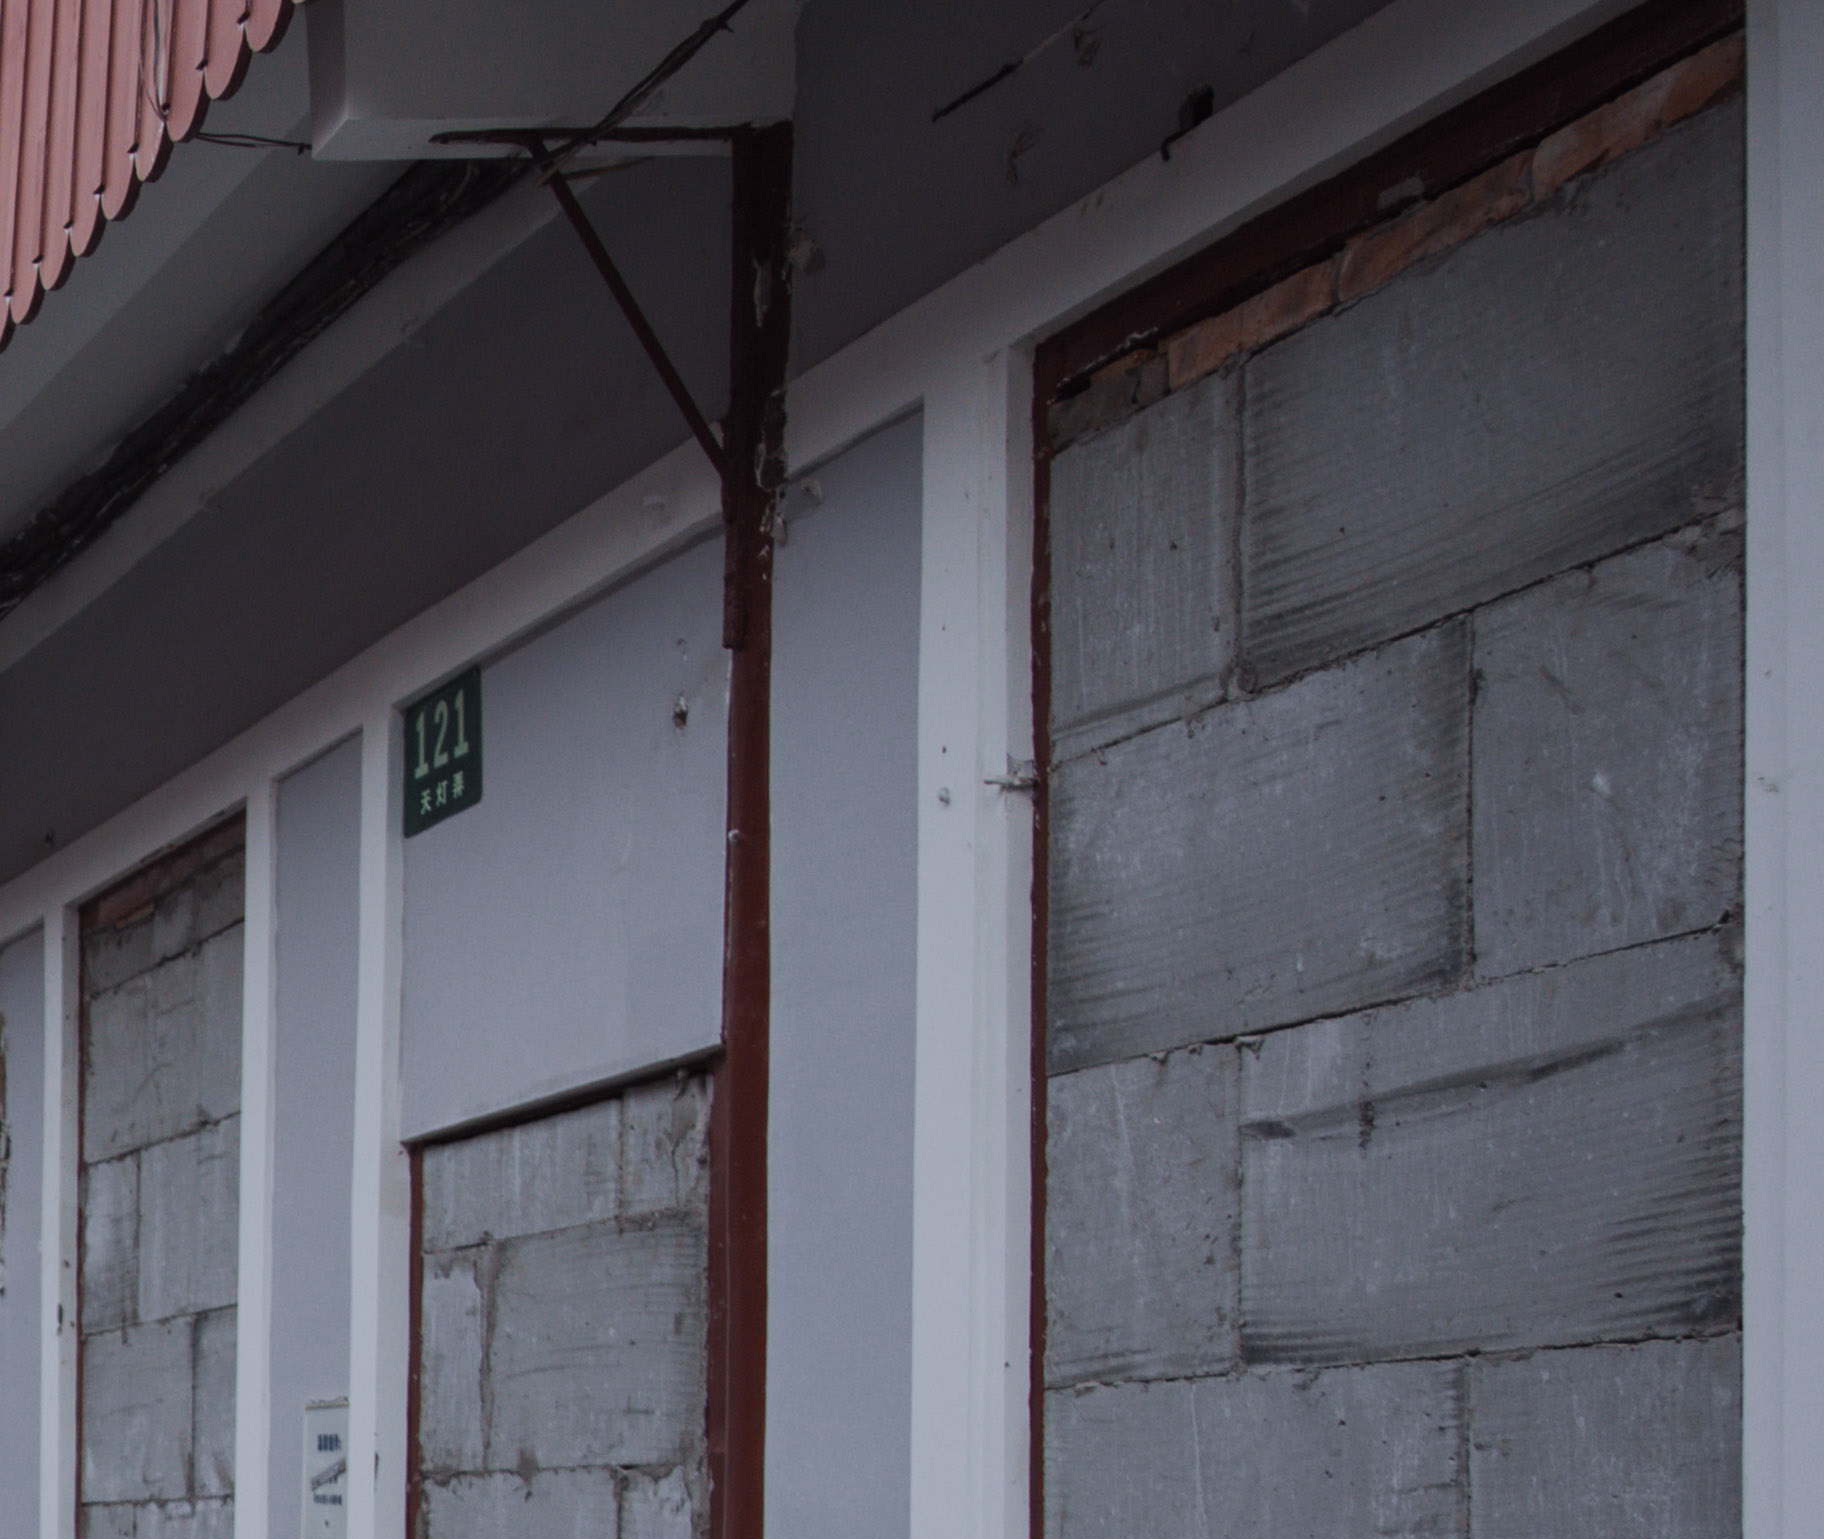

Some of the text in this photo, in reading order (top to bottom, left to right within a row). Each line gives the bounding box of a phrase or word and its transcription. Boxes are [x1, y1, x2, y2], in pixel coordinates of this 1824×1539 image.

[414, 689, 469, 779] 121
[420, 772, 464, 814] 天灯弄
